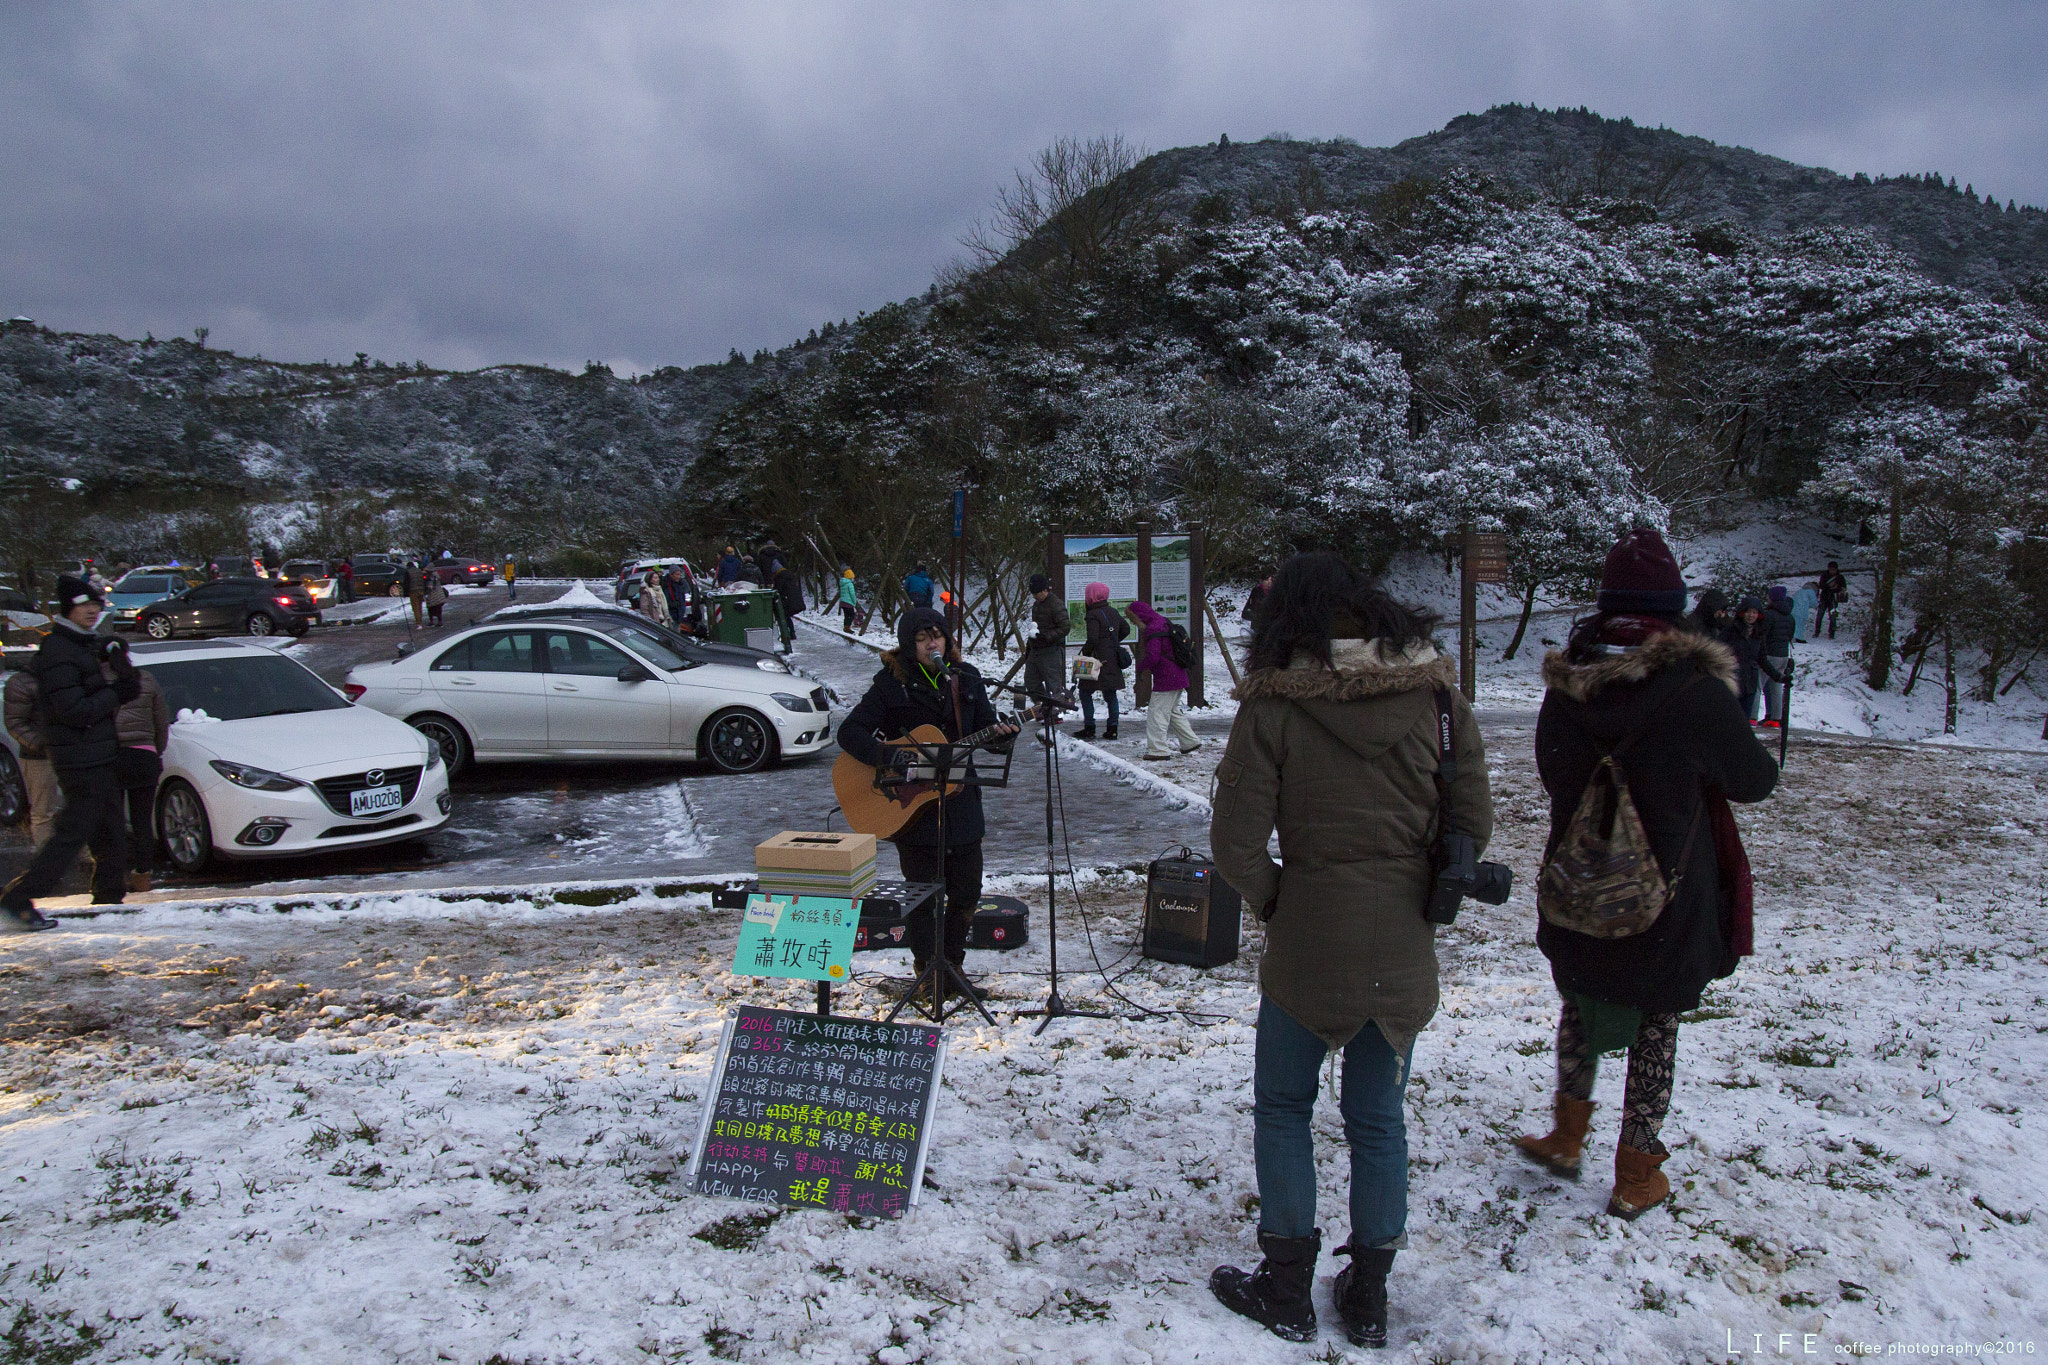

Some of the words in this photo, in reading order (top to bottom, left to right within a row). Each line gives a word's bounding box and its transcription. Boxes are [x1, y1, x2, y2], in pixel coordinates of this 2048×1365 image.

[1441, 713, 1450, 751] Canon
[353, 790, 400, 812] AMU-0208
[755, 937, 833, 971] 蕭牧時
[705, 1160, 765, 1182] HAPPY
[700, 1180, 734, 1196] NEW
[741, 1184, 778, 1204] YEAR
